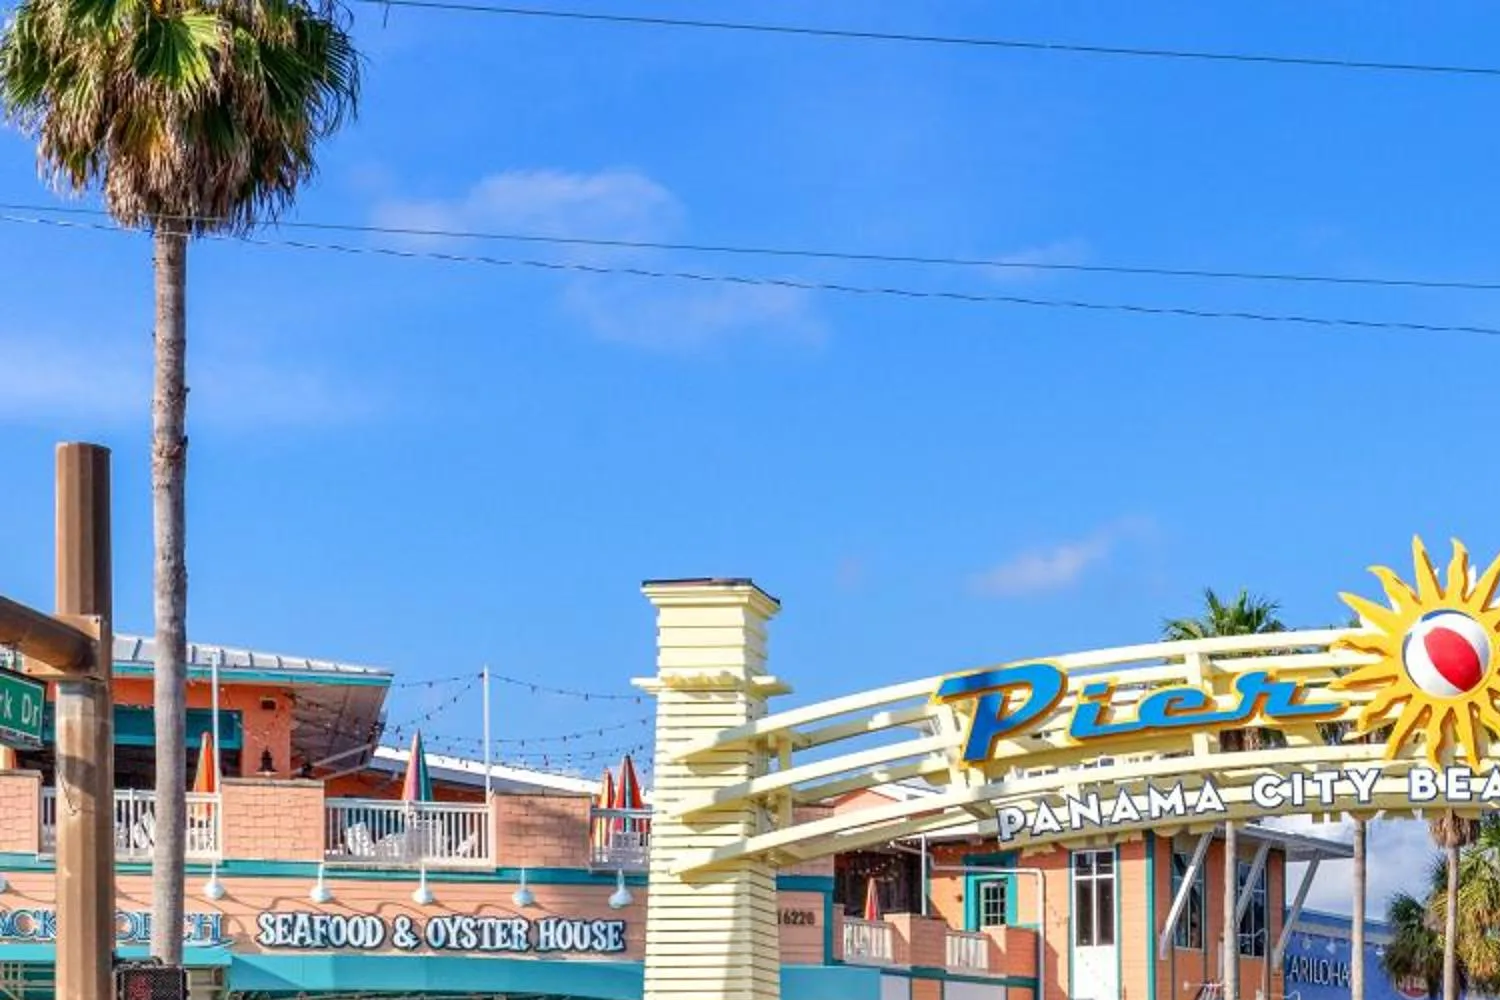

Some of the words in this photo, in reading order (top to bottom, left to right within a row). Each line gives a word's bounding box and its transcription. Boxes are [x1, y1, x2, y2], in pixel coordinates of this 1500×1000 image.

[0, 687, 13, 720] k
[21, 692, 39, 727] Dr
[936, 661, 1347, 766] Pier
[996, 775, 1226, 842] PANAMA
[1252, 768, 1382, 807] CITY
[257, 911, 385, 949] SEAFOOD
[392, 914, 419, 950] &
[425, 914, 530, 952] OYSTER
[536, 919, 626, 953] HOUSE
